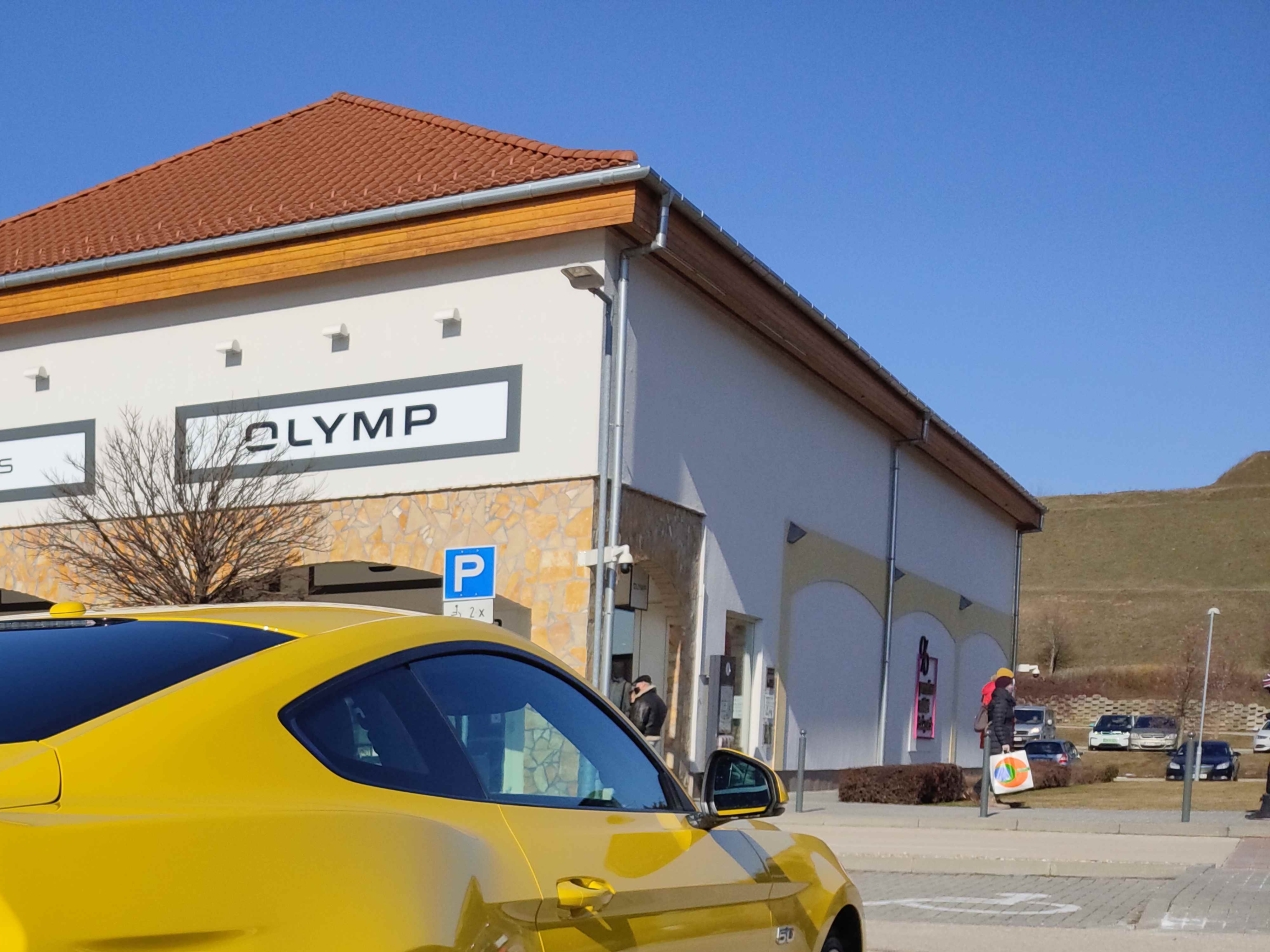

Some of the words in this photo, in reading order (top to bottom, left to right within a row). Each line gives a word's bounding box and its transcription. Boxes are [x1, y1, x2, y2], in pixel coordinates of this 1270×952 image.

[245, 403, 438, 452] OLYMP
[454, 553, 485, 593] P
[469, 606, 475, 618] 2
